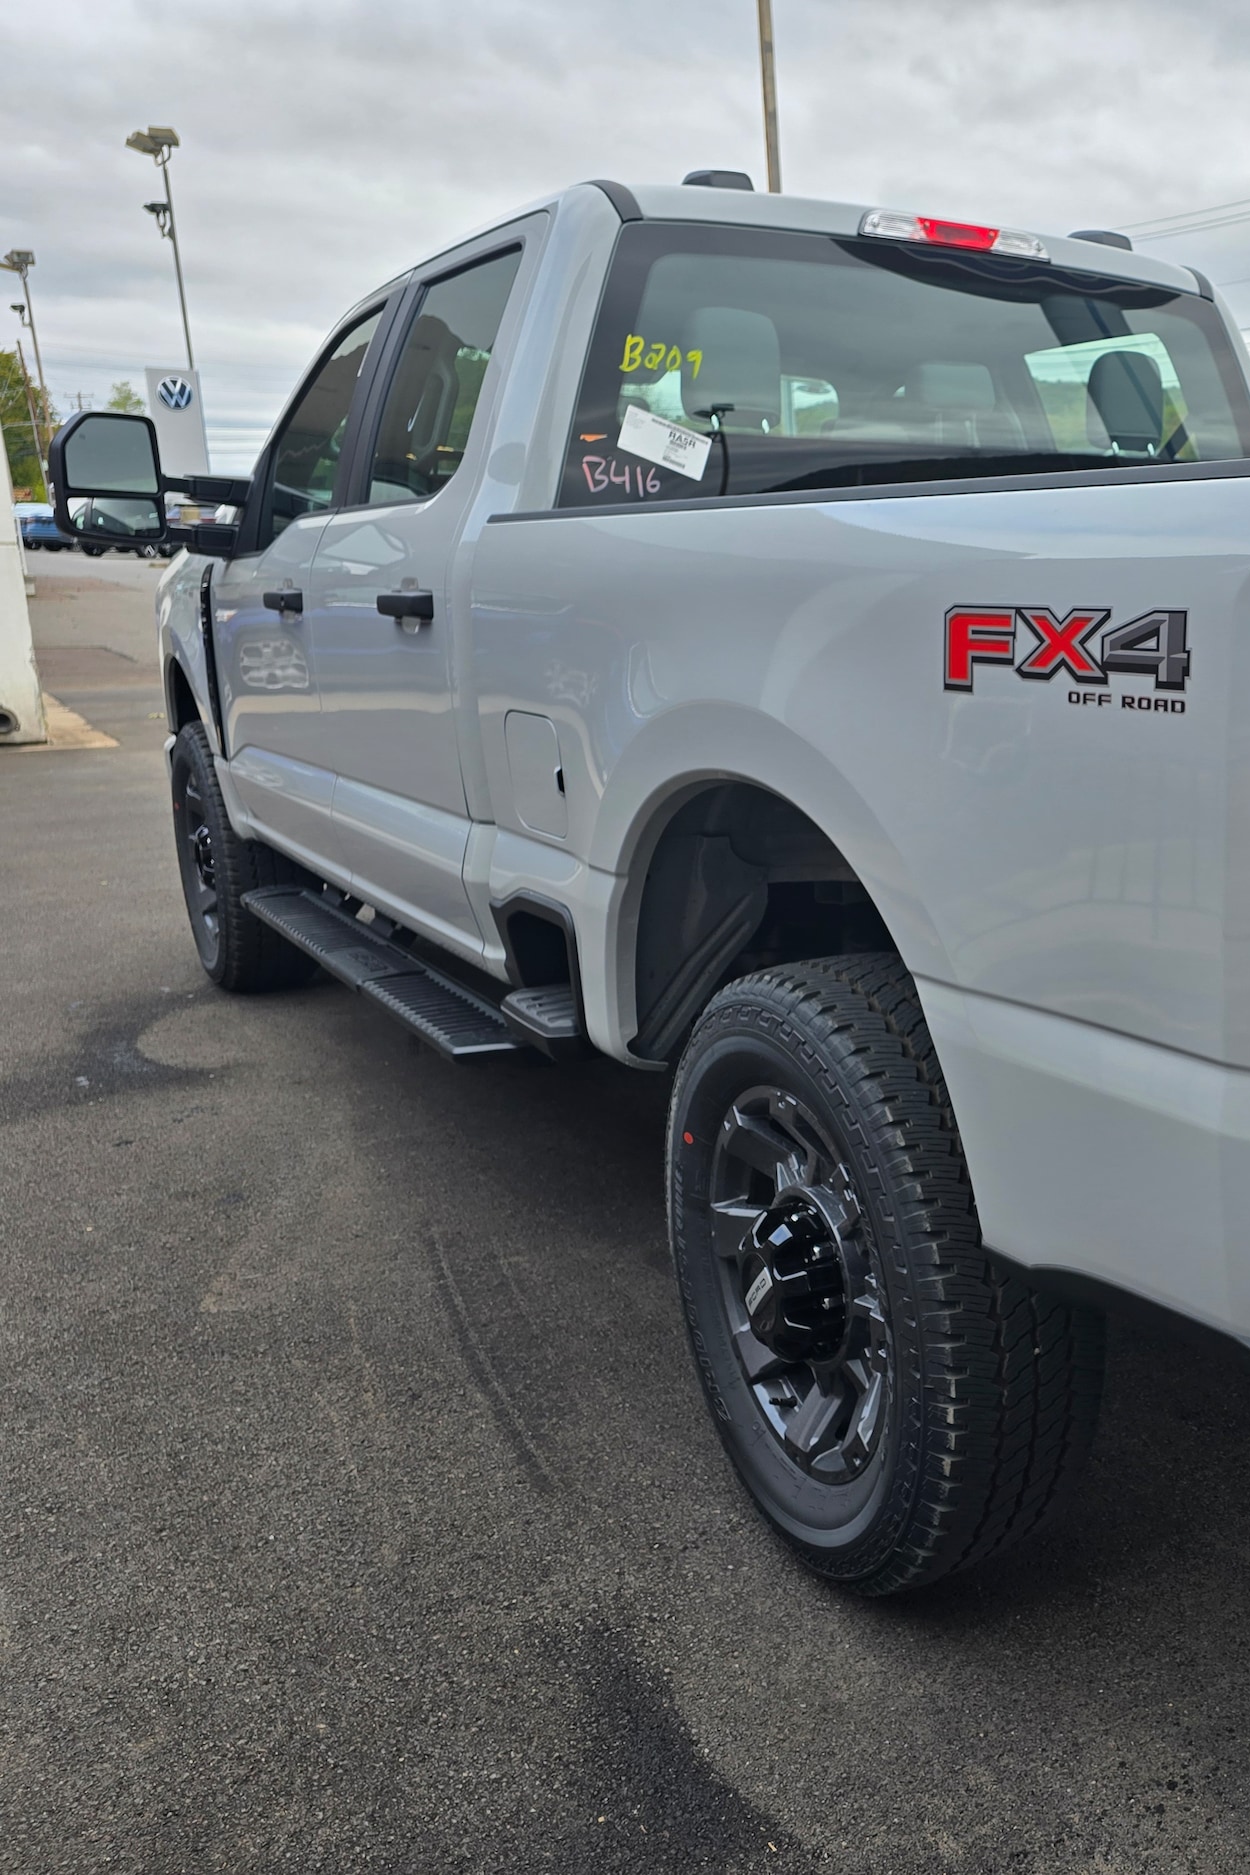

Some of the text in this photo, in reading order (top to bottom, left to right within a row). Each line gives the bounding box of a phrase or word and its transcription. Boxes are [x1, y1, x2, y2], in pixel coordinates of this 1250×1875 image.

[582, 455, 661, 498] B416
[943, 603, 1192, 694] FX4
[1067, 690, 1187, 714] OFF ROAD
